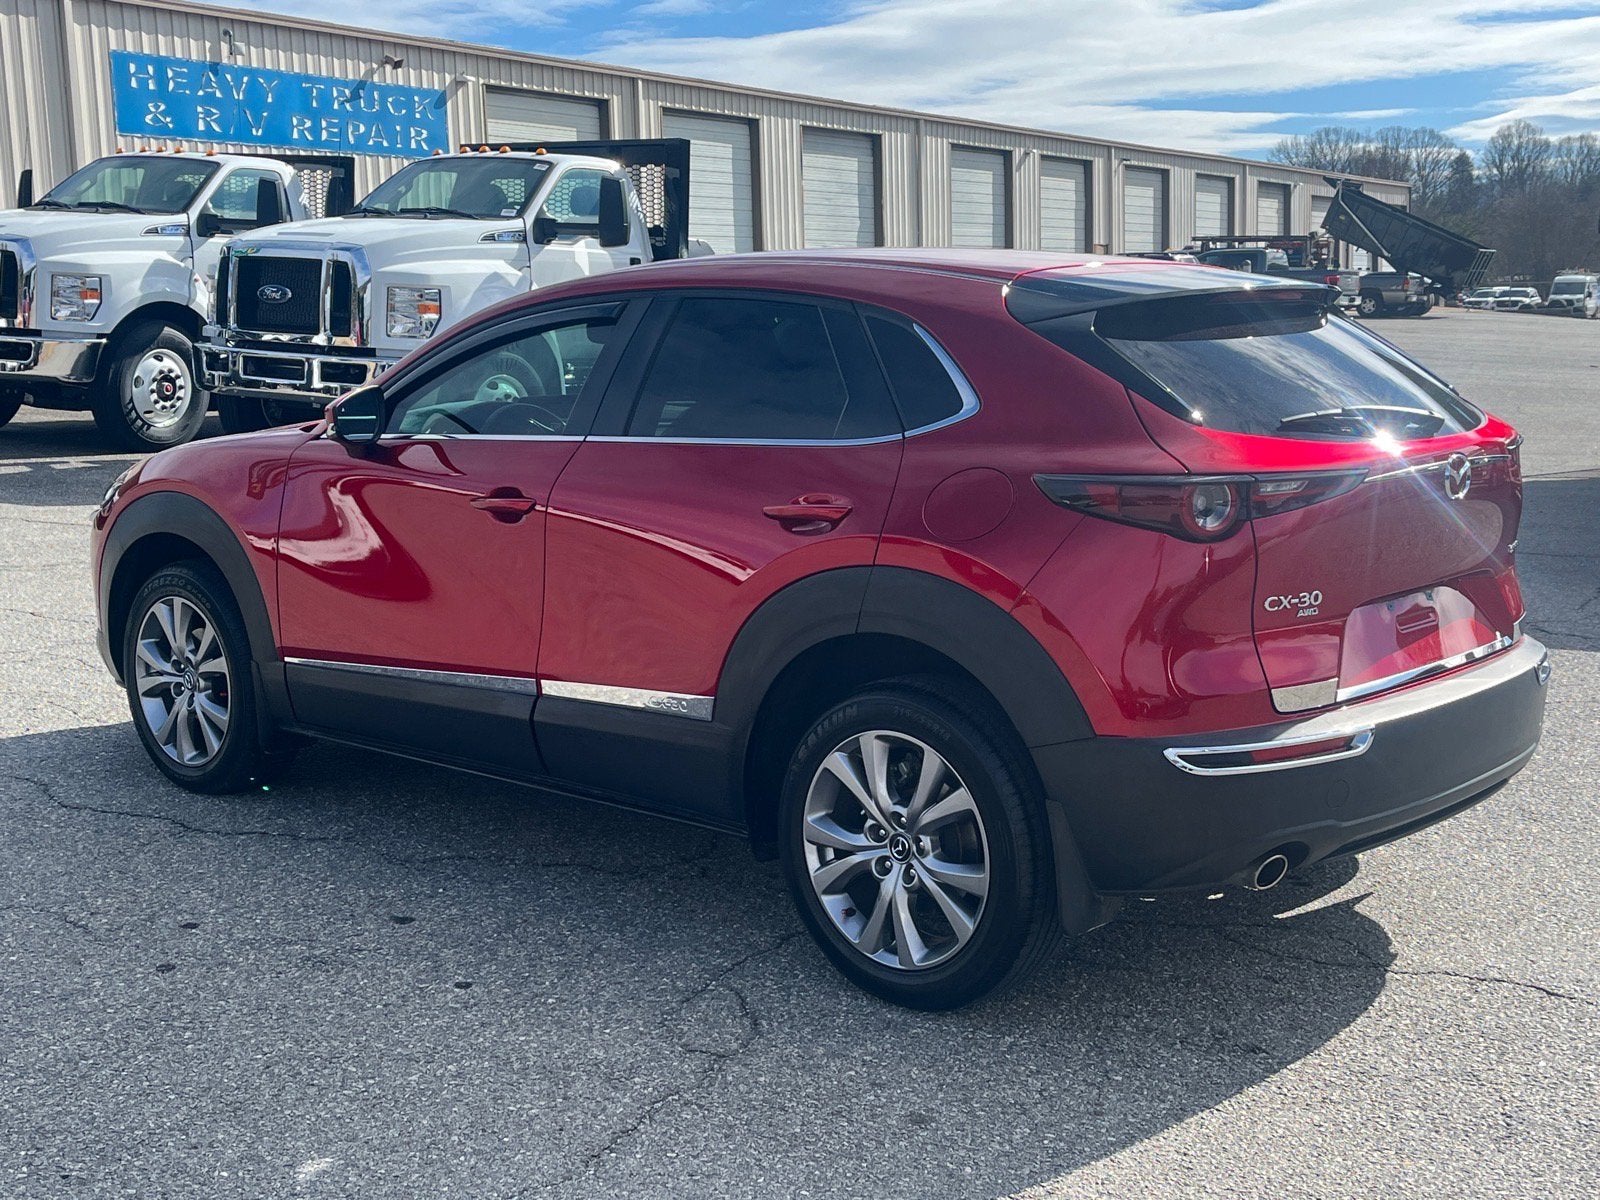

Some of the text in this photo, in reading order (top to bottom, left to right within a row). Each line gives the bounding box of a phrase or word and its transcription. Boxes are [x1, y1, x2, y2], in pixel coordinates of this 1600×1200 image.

[129, 61, 435, 121] HEAVY TRUCK
[145, 102, 174, 129] &
[292, 115, 429, 151] REPAIR
[263, 287, 282, 299] Ford
[1264, 590, 1323, 611] CX-30
[1297, 607, 1319, 618] AWD
